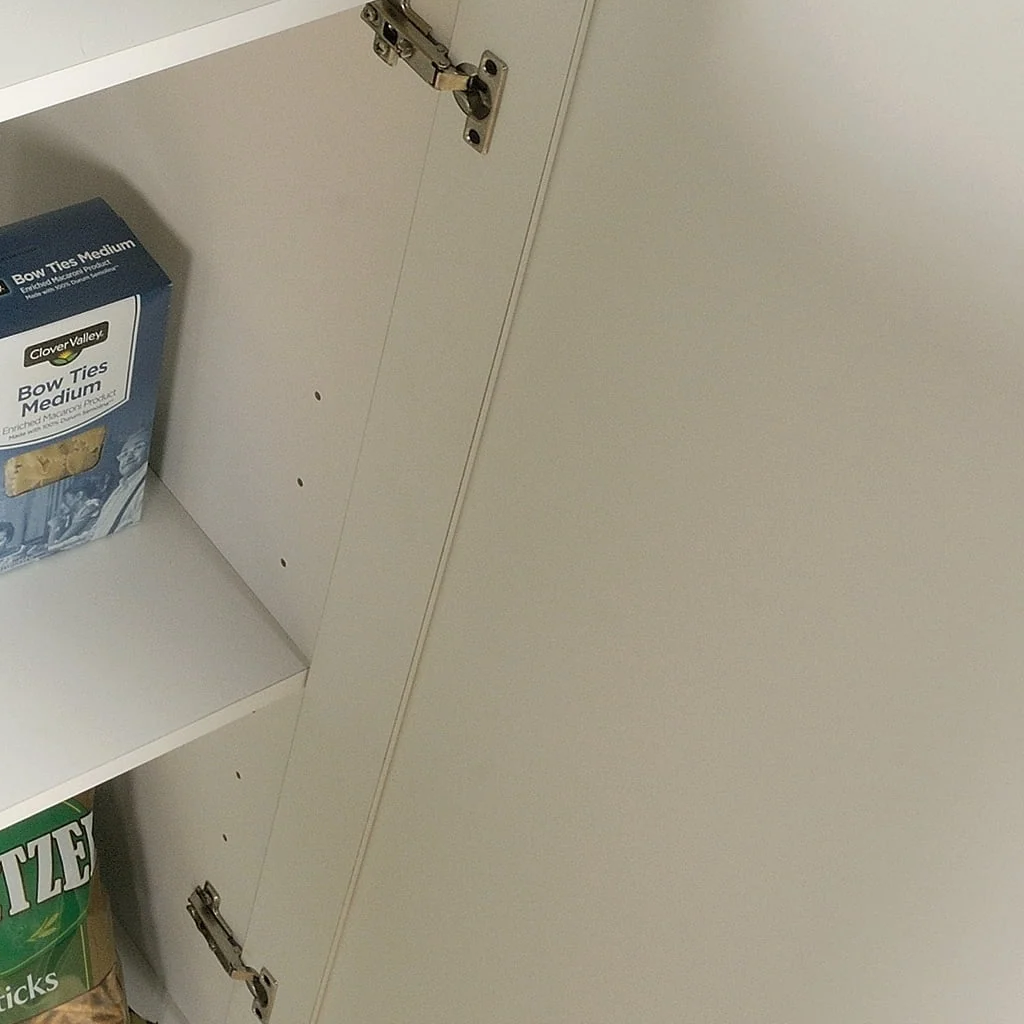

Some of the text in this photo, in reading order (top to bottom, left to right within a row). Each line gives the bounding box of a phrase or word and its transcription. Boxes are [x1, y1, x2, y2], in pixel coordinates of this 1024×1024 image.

[12, 239, 136, 286] Bow Ties Medium
[20, 279, 52, 295] Enriched
[84, 259, 112, 274] Product
[26, 291, 42, 301] Made
[30, 329, 104, 360] Clover Valley
[18, 361, 108, 402] Bow Ties
[21, 380, 102, 417] Medium
[2, 389, 117, 435] Enriched Macaroni Product
